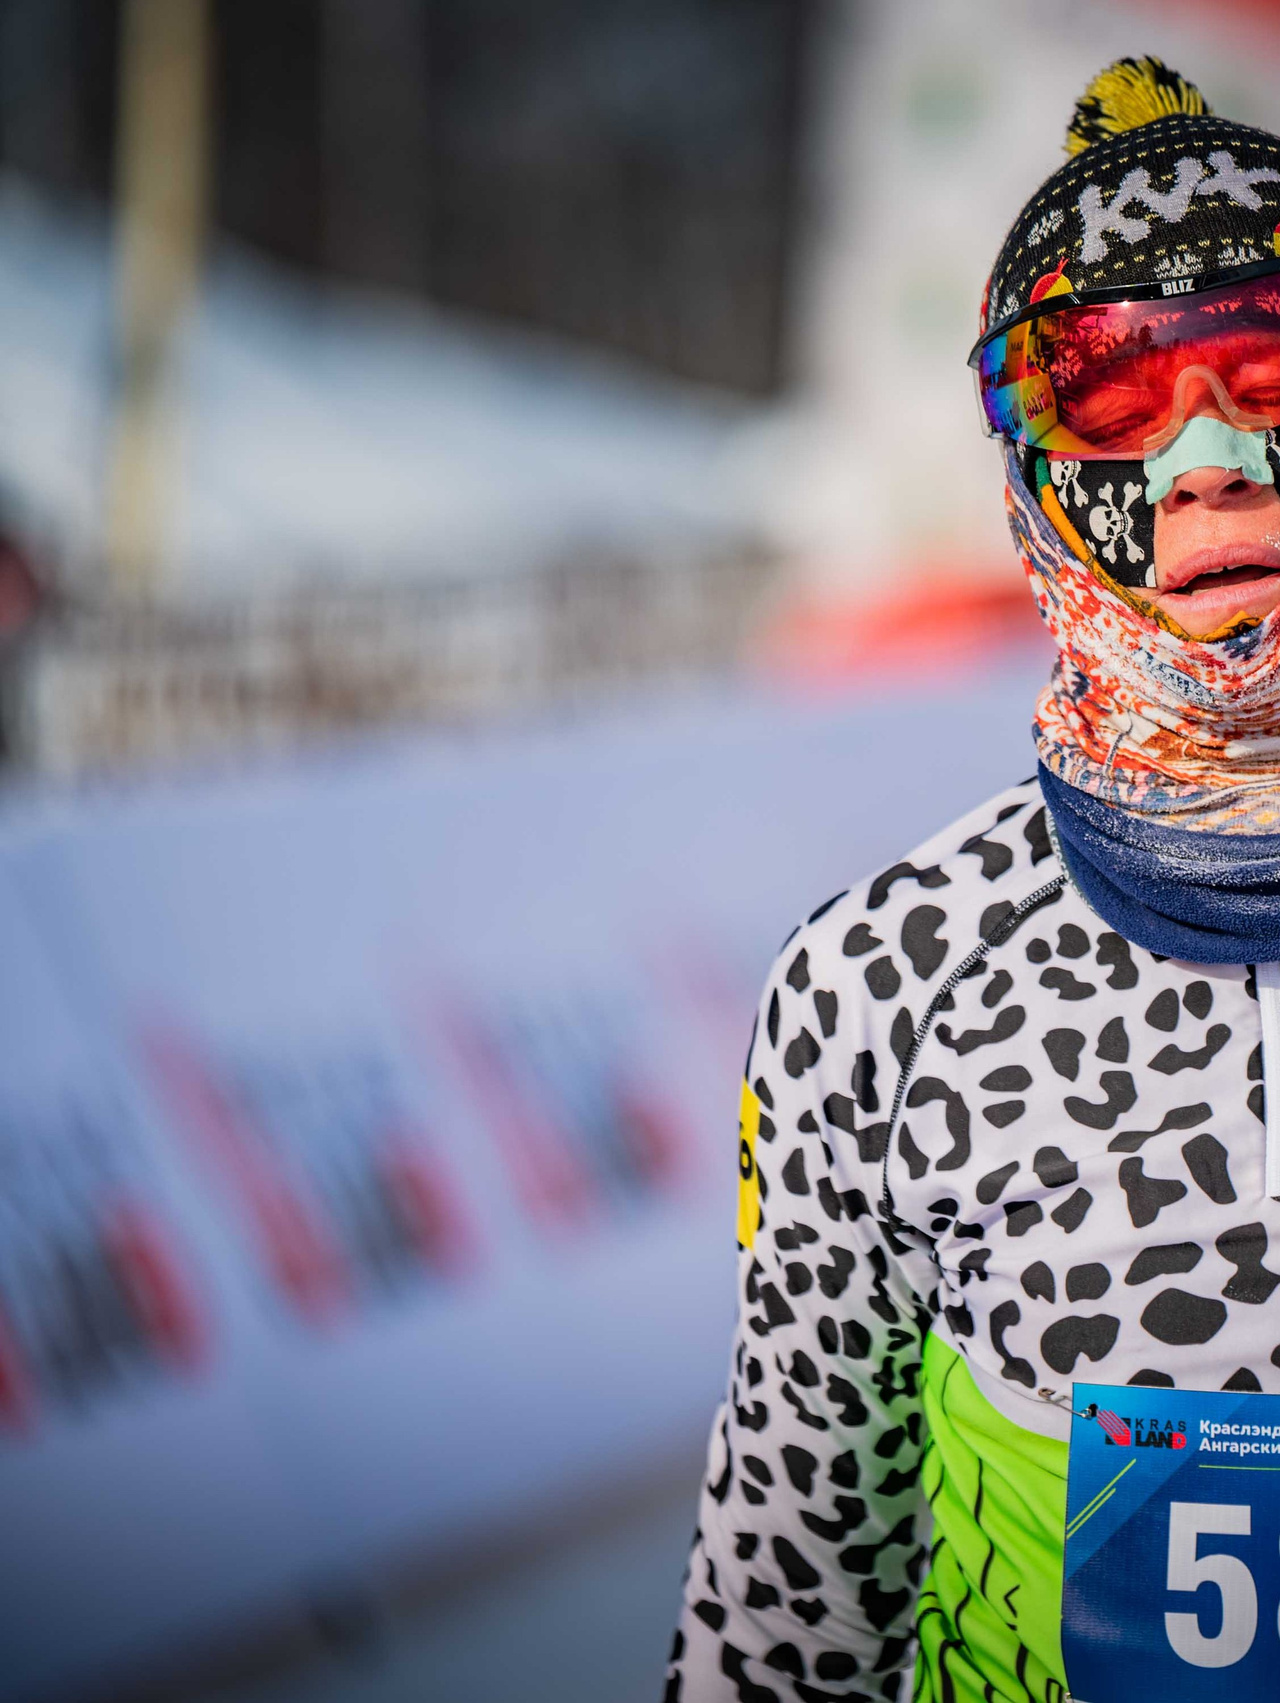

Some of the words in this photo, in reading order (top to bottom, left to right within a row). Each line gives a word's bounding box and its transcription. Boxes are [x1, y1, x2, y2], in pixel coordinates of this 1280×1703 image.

[1161, 278, 1195, 296] BLIZ
[1135, 1418, 1187, 1432] KRAS
[1135, 1431, 1187, 1450] LAND
